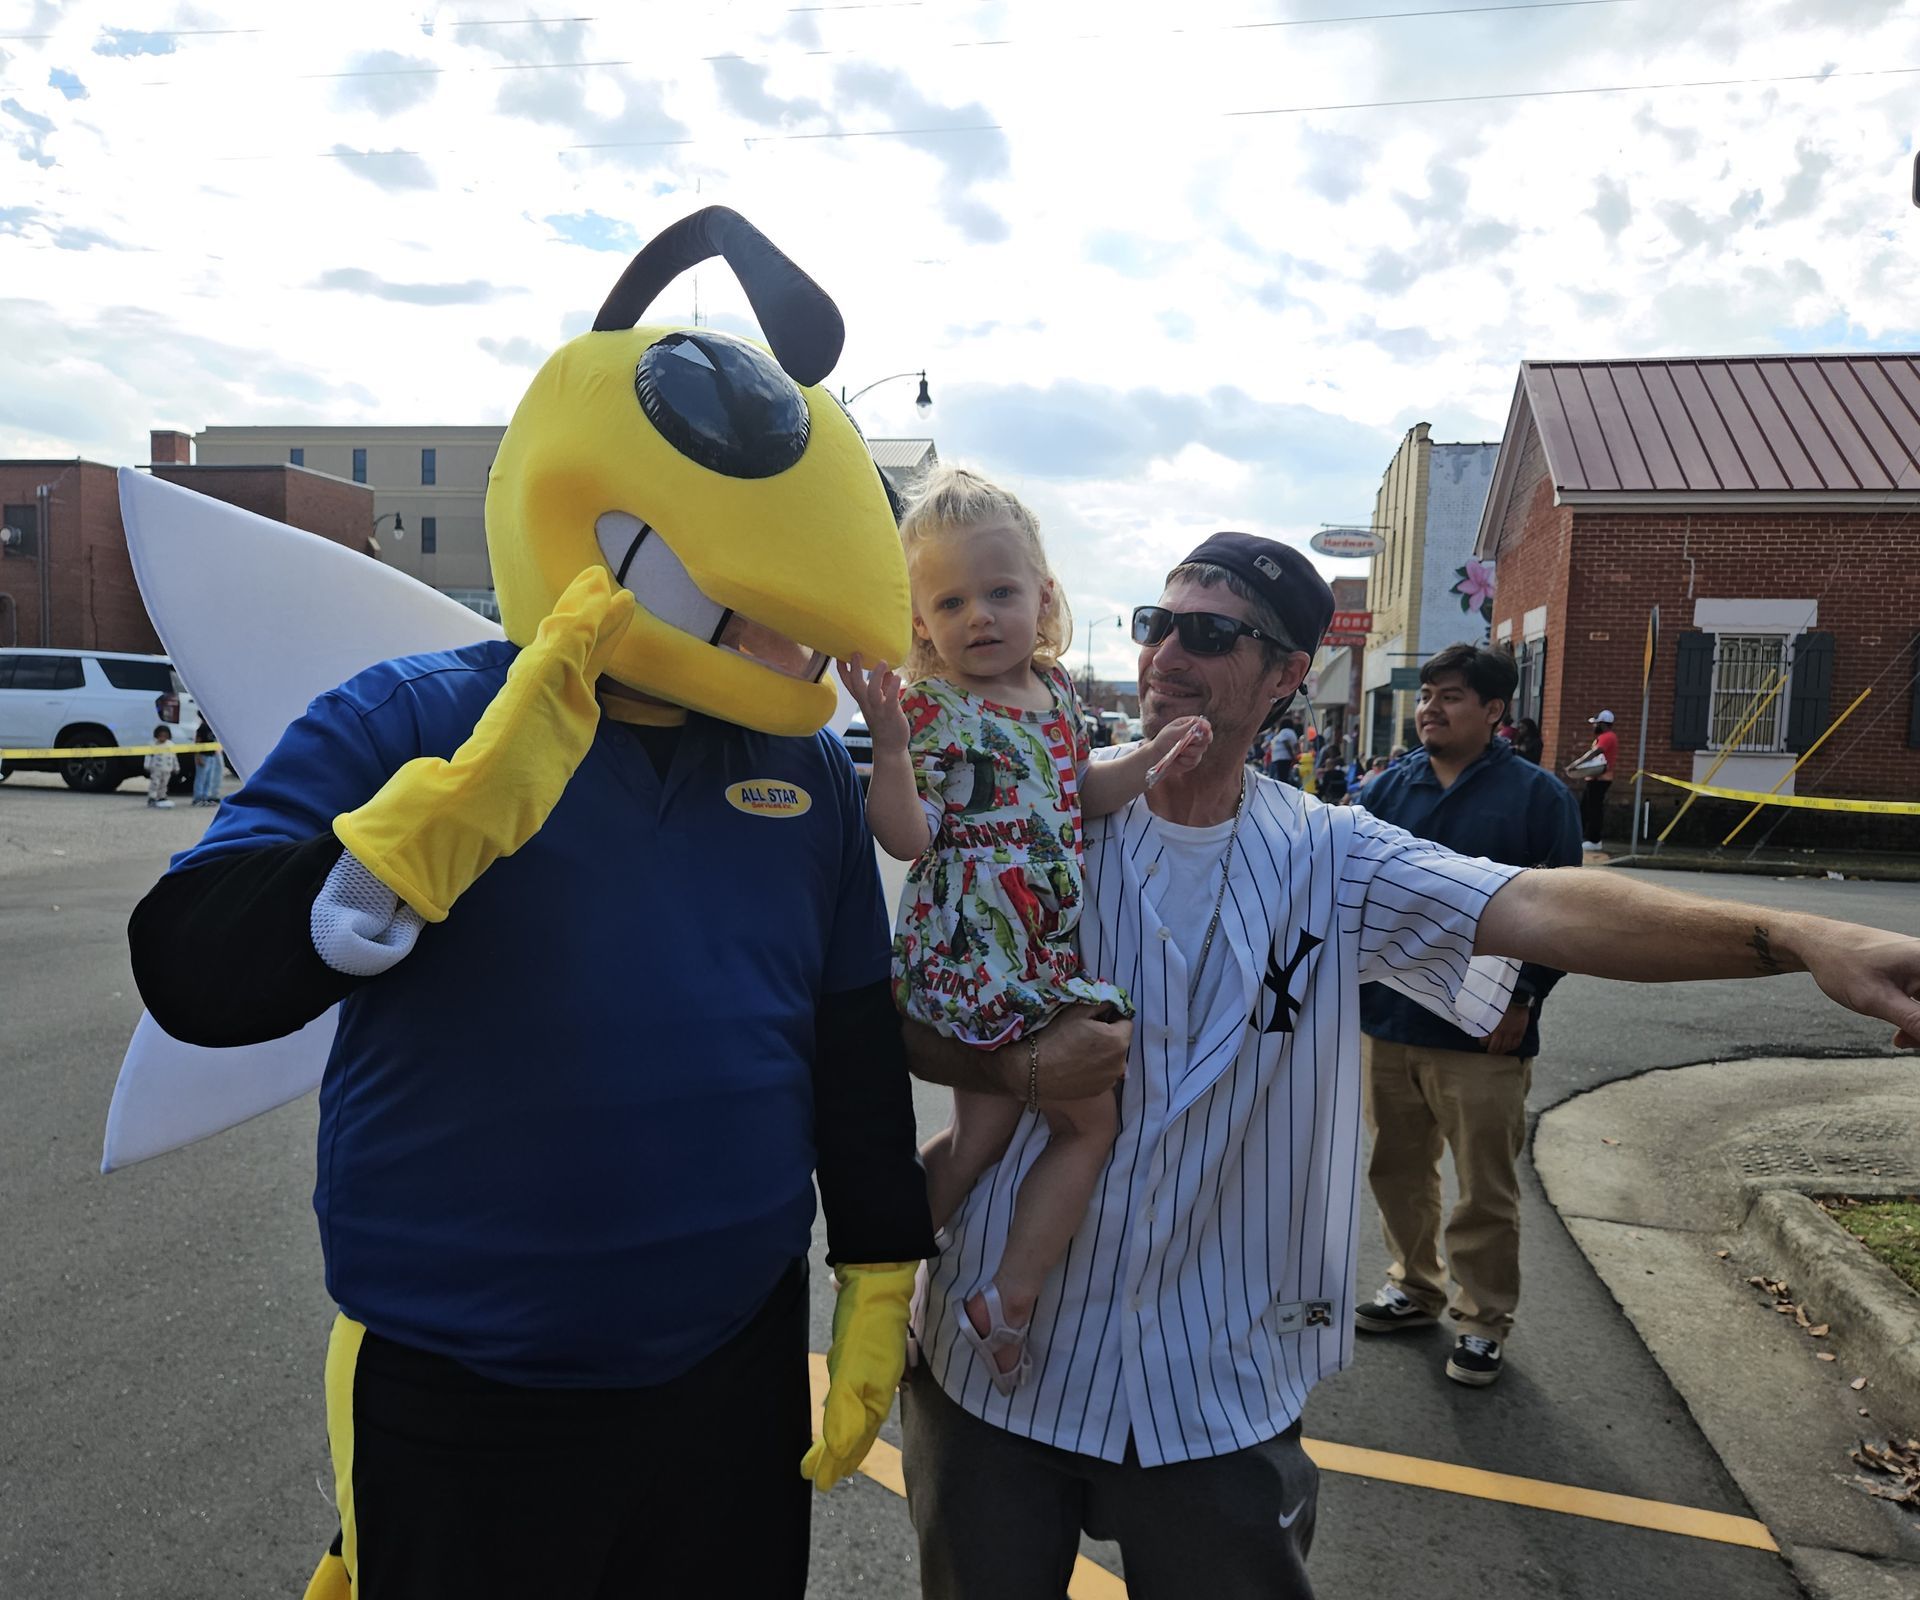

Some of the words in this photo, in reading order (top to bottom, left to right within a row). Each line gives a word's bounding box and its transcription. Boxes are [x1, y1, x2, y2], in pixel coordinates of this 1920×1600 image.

[1323, 538, 1374, 548] Hardware
[741, 787, 767, 803] ALL
[767, 788, 799, 804] STAR
